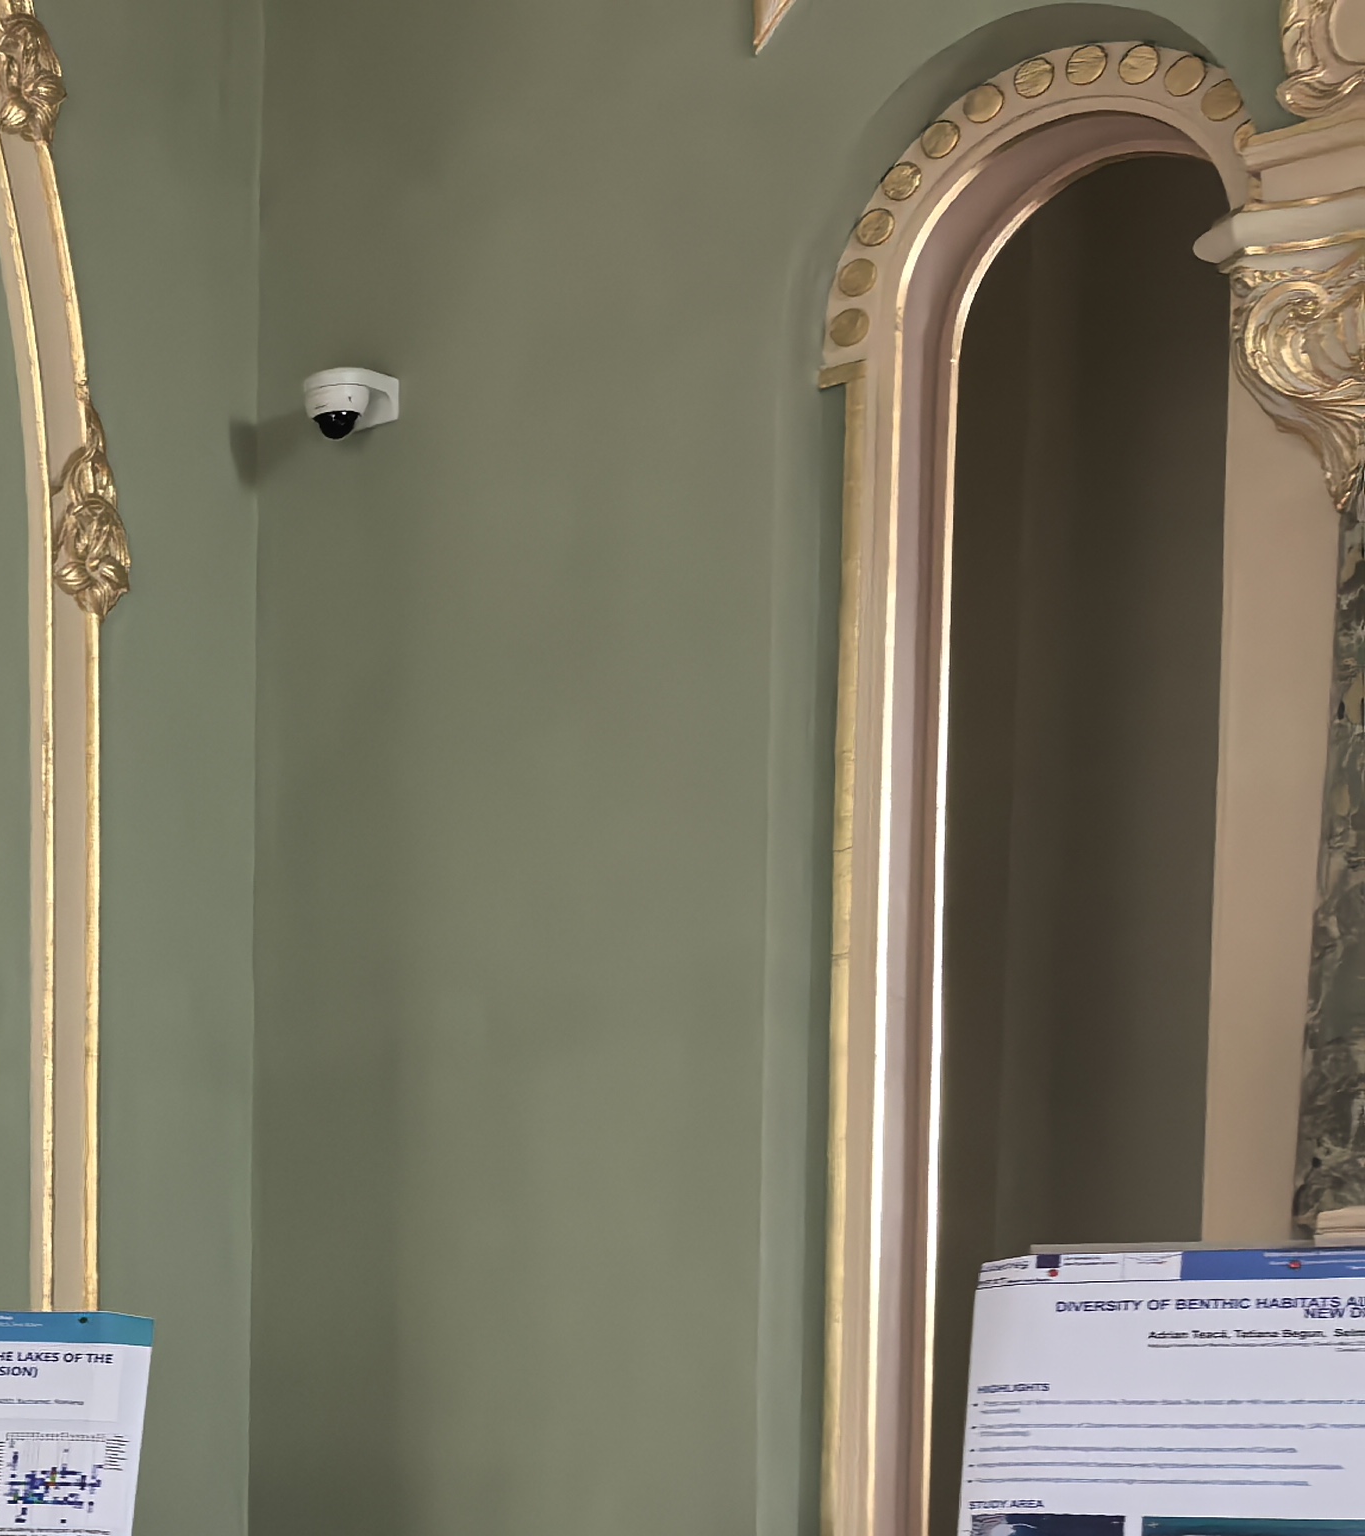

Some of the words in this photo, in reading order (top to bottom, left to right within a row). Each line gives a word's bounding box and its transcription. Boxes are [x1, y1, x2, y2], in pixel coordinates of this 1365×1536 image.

[1055, 1300, 1143, 1312] DIVERSITY
[1147, 1299, 1171, 1311] OF
[1175, 1298, 1251, 1310] BENTHIC
[1256, 1297, 1341, 1308] HABITATS
[1303, 1308, 1345, 1318] NEW
[1148, 1331, 1188, 1339] Adrian
[1234, 1330, 1279, 1338] Tatiana
[17, 1352, 59, 1363] LAKES
[63, 1352, 85, 1364] OF
[86, 1353, 114, 1364] THE
[977, 1383, 1050, 1394] HIGHLIGHTS
[969, 1500, 1007, 1510] STUDY
[1010, 1500, 1045, 1508] AREA
